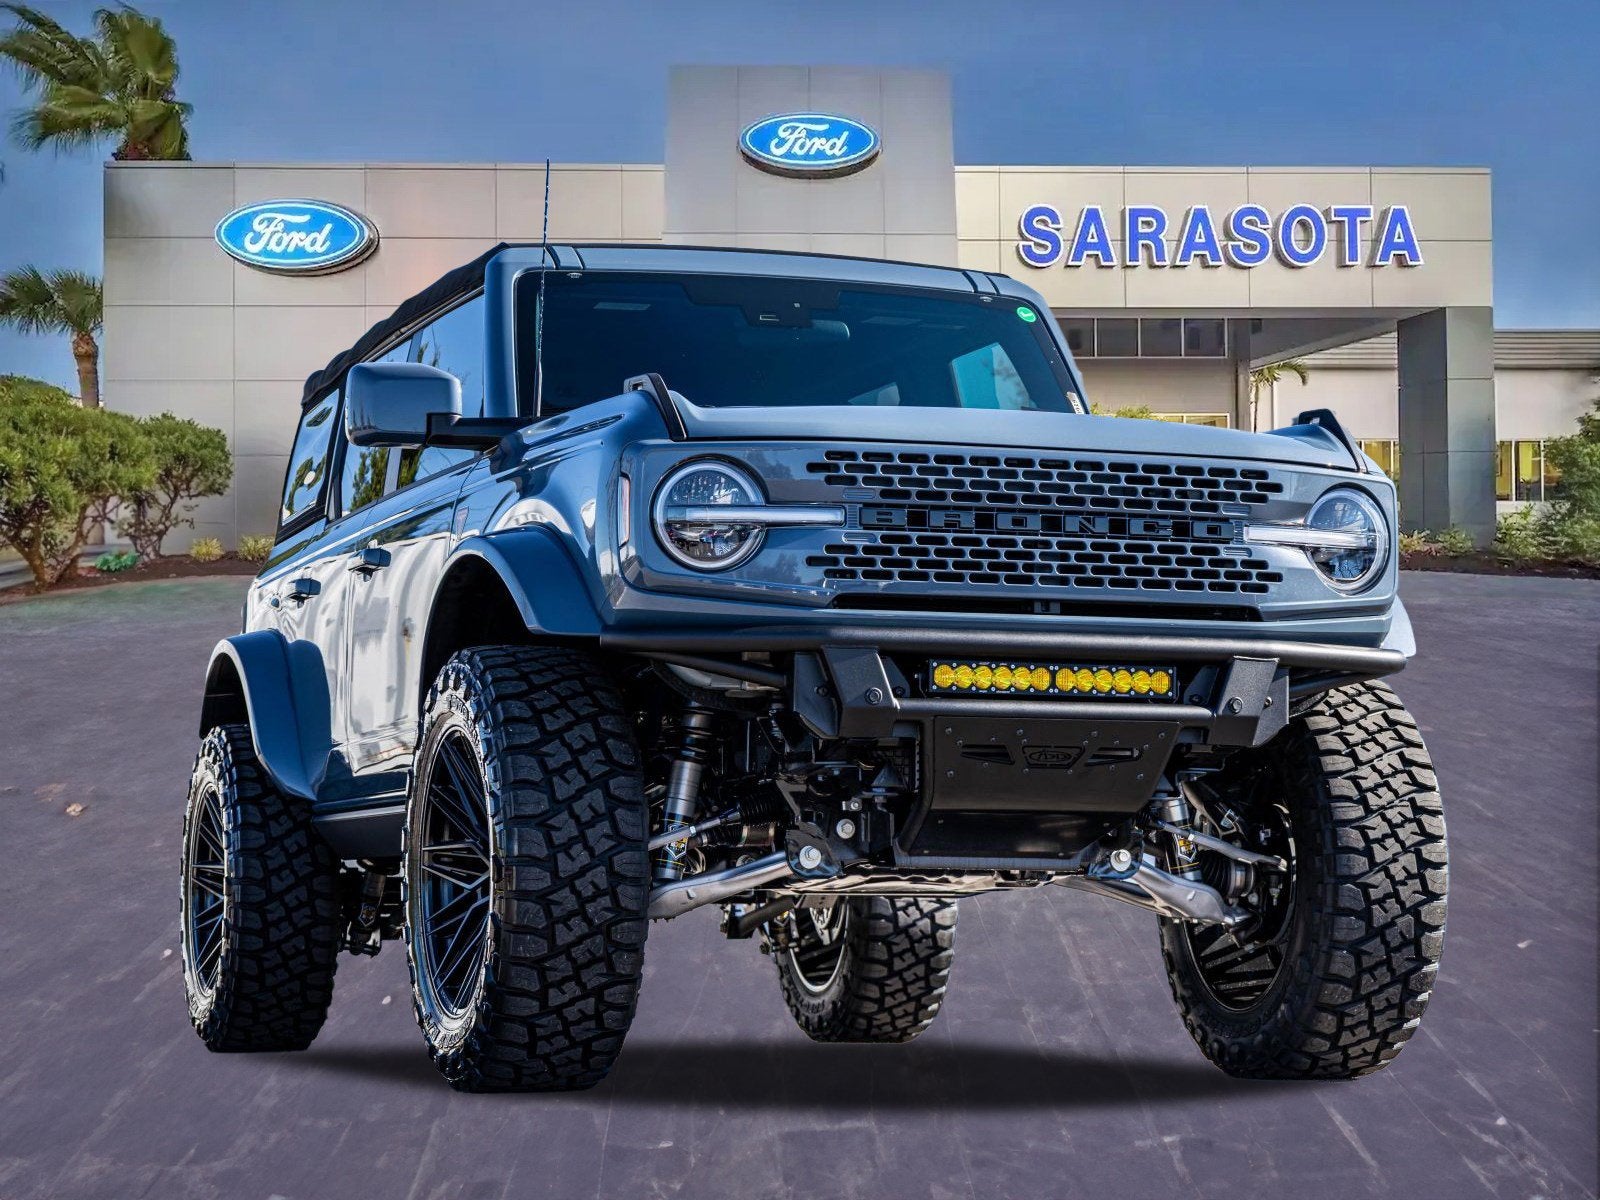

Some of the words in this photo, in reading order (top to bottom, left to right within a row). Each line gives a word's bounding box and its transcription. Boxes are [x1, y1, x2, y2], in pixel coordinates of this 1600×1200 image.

[769, 121, 849, 157] Ford
[244, 212, 333, 254] Ford
[1018, 203, 1424, 268] SARASOTA
[860, 506, 1234, 541] BRONCO
